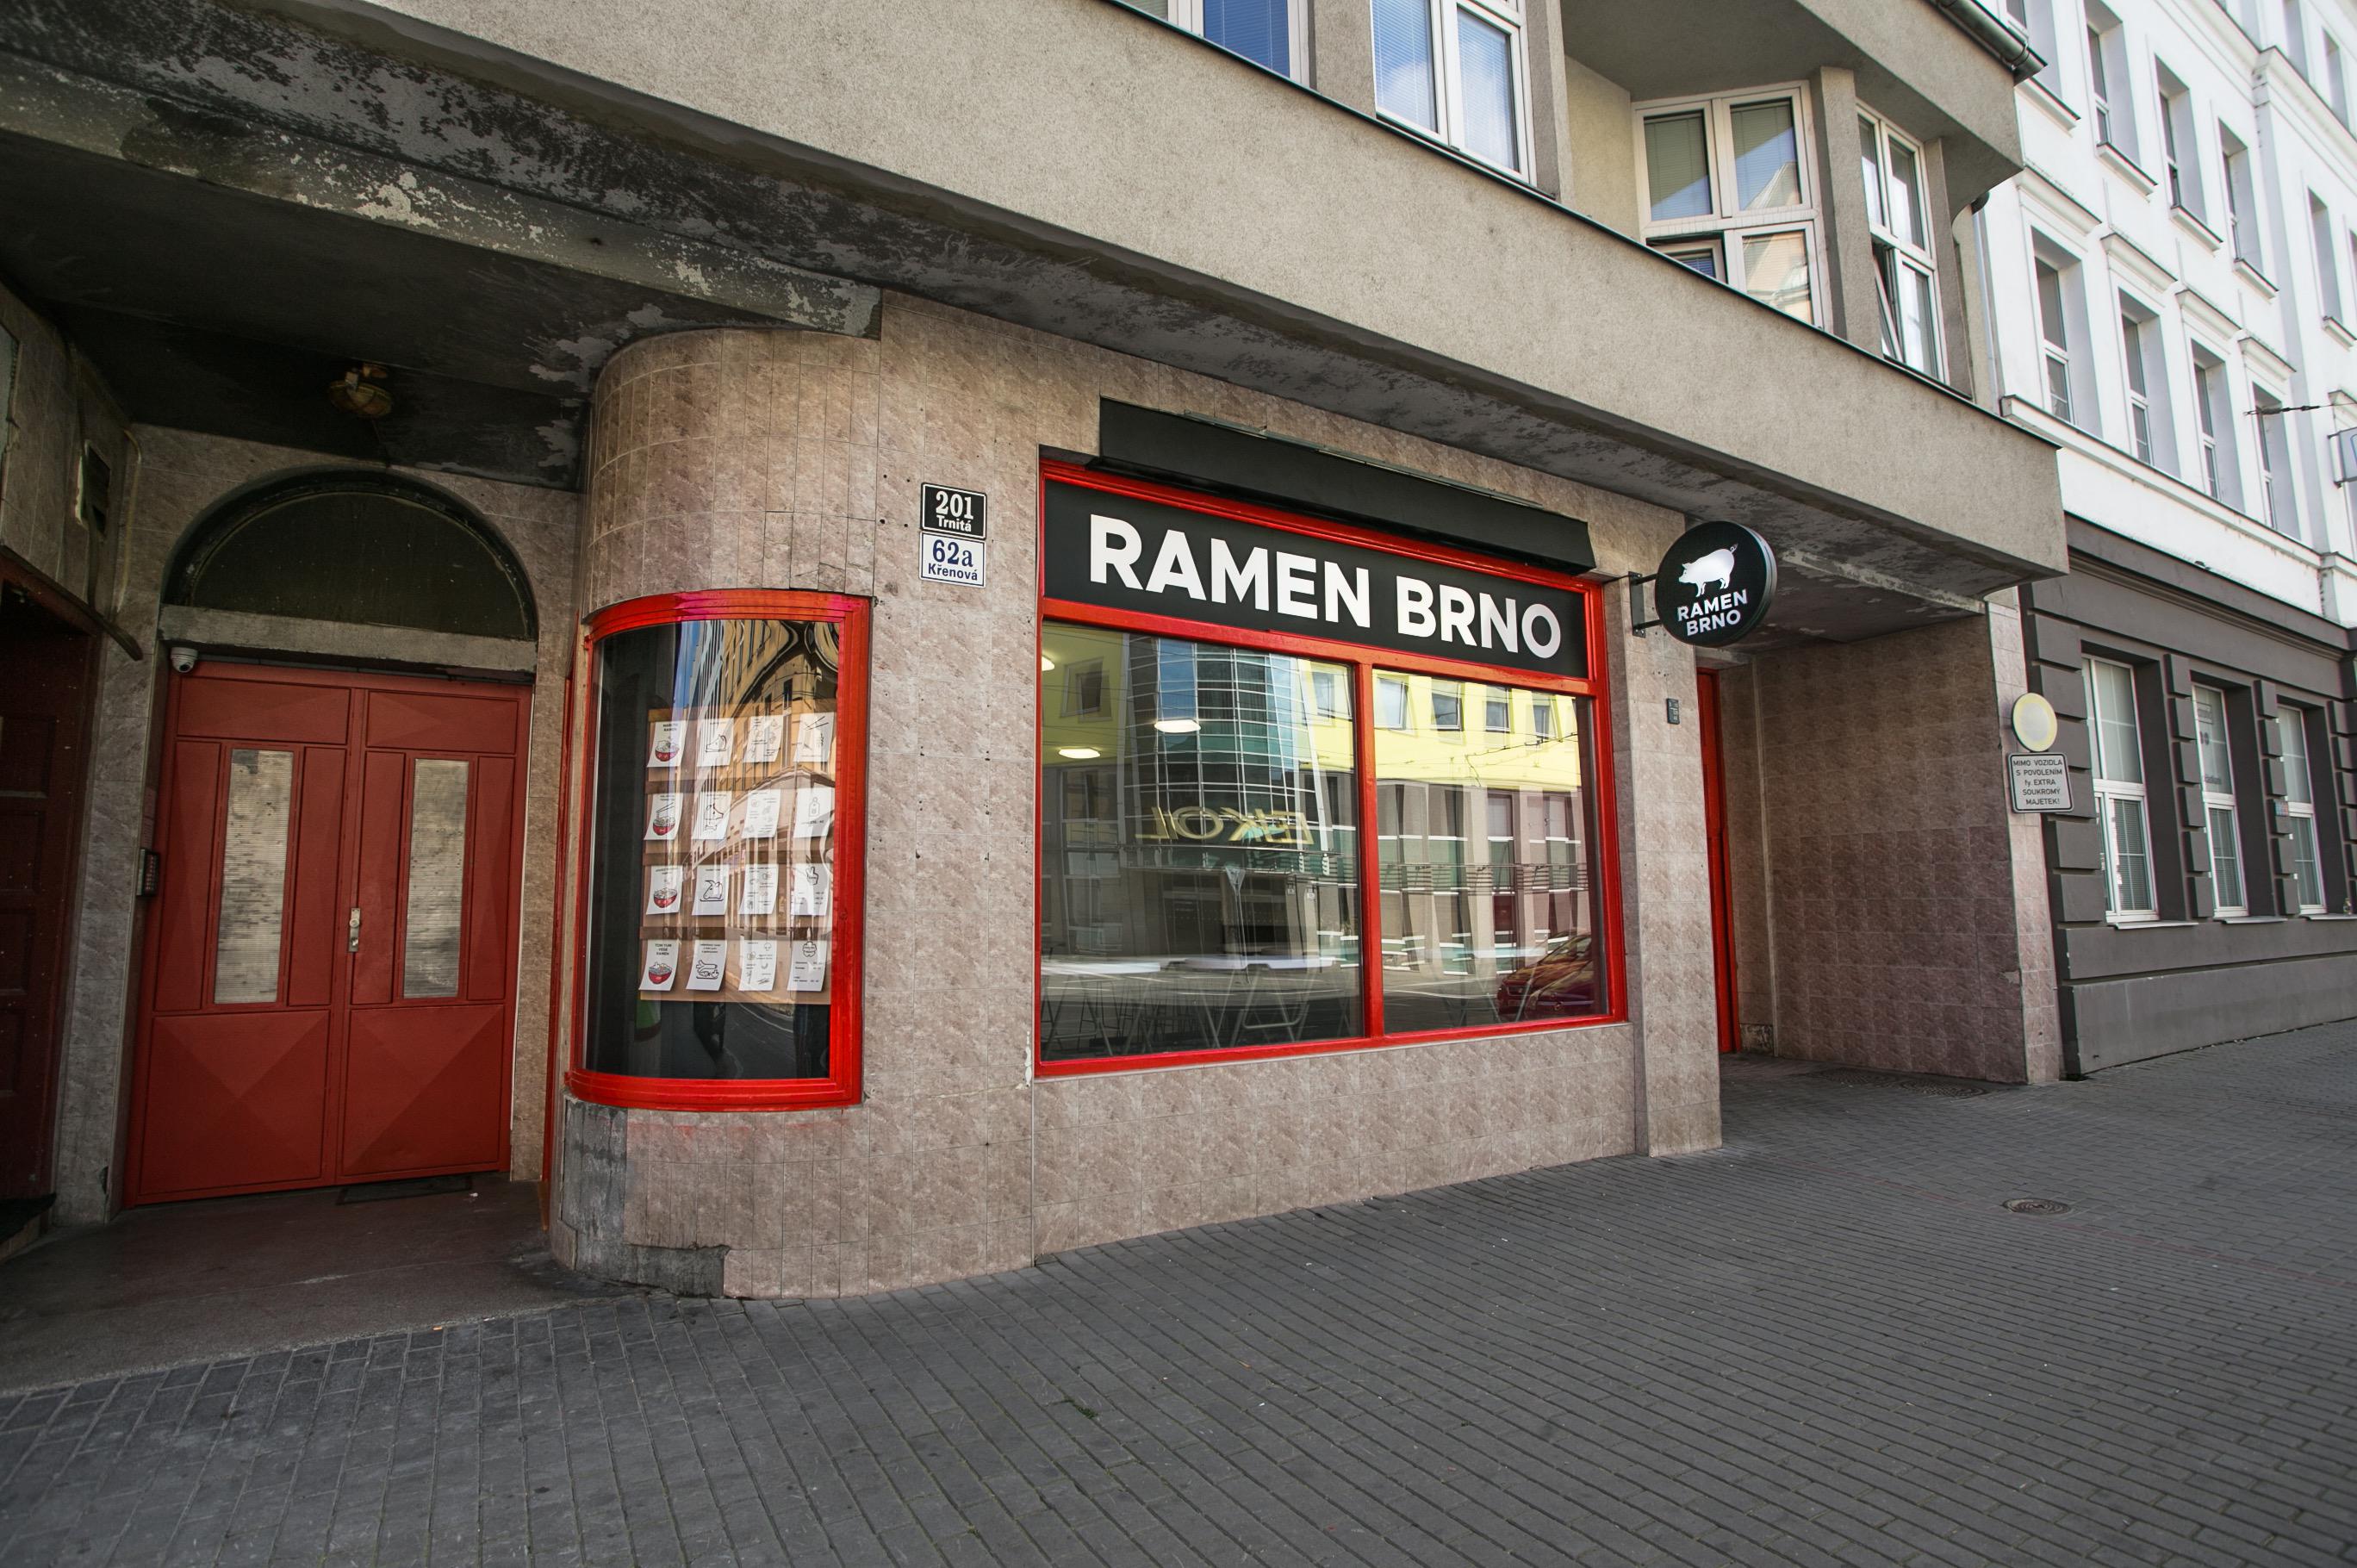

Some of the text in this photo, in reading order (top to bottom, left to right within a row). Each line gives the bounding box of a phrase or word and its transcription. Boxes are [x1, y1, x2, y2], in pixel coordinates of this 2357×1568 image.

[935, 490, 974, 520] 201
[936, 514, 972, 532] Trnitá
[932, 538, 973, 568] 62a
[928, 563, 978, 581] Křenová
[1089, 513, 1561, 659] RAMEN BRNO
[1676, 588, 1749, 622] RAMEN
[1686, 609, 1742, 637] BRNO
[2023, 768, 2063, 776] POVOLENÍM
[2022, 787, 2061, 796] SOUKROMÝ
